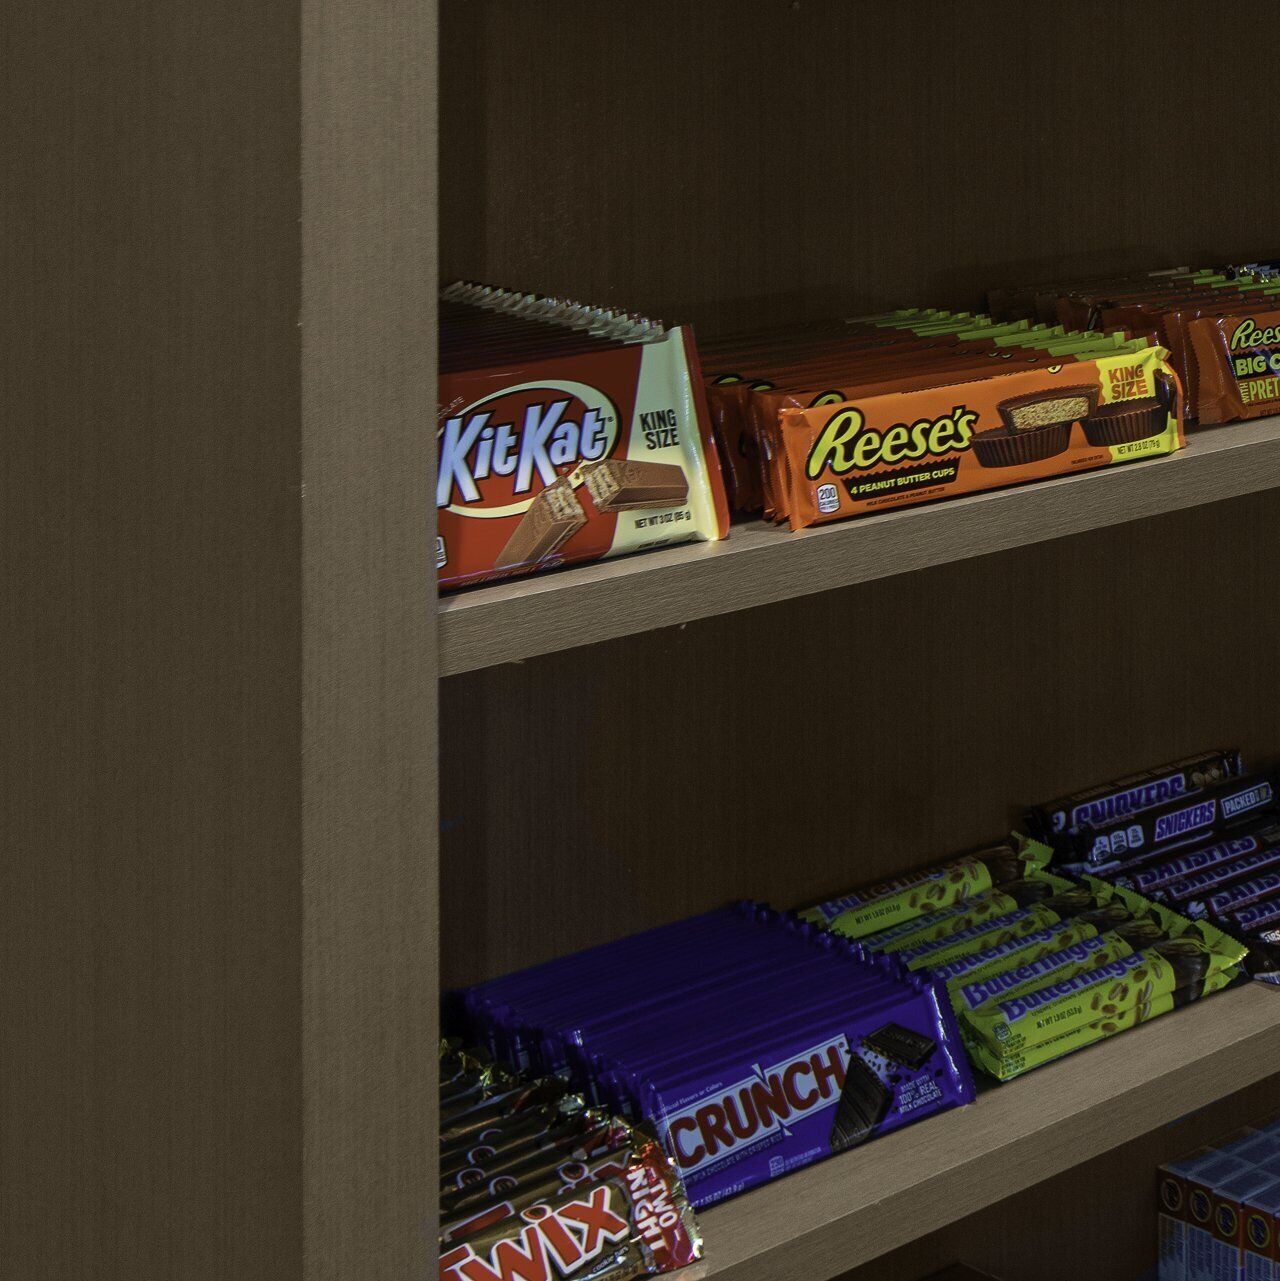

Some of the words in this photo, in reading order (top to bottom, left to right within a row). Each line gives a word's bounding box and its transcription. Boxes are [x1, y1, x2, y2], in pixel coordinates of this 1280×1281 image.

[1108, 363, 1146, 385] KING
[1235, 353, 1267, 377] BIG
[1111, 378, 1149, 401] SIZE
[1239, 381, 1250, 406] WITH
[638, 408, 678, 434] KING
[645, 427, 681, 451] SIZE
[806, 405, 979, 479] Reese's
[1117, 445, 1128, 455] NET
[1127, 443, 1135, 454] WT
[1134, 441, 1143, 452] 2.8
[1142, 441, 1150, 451] OZ
[818, 487, 837, 501] 200
[850, 485, 858, 495] 4
[859, 479, 896, 495] PEANUT
[896, 473, 931, 486] BUTTER
[931, 467, 956, 480] CUPS
[1156, 801, 1216, 841] SNICKERS
[1224, 791, 1257, 814] PACKED
[961, 935, 1107, 1009] Butterfinger
[998, 950, 1146, 1022] Butterfinger
[918, 1079, 939, 1096] REAL
[668, 1045, 850, 1169] CRUNCH
[626, 1167, 669, 1252] NIGHT
[651, 1179, 679, 1229] TWO
